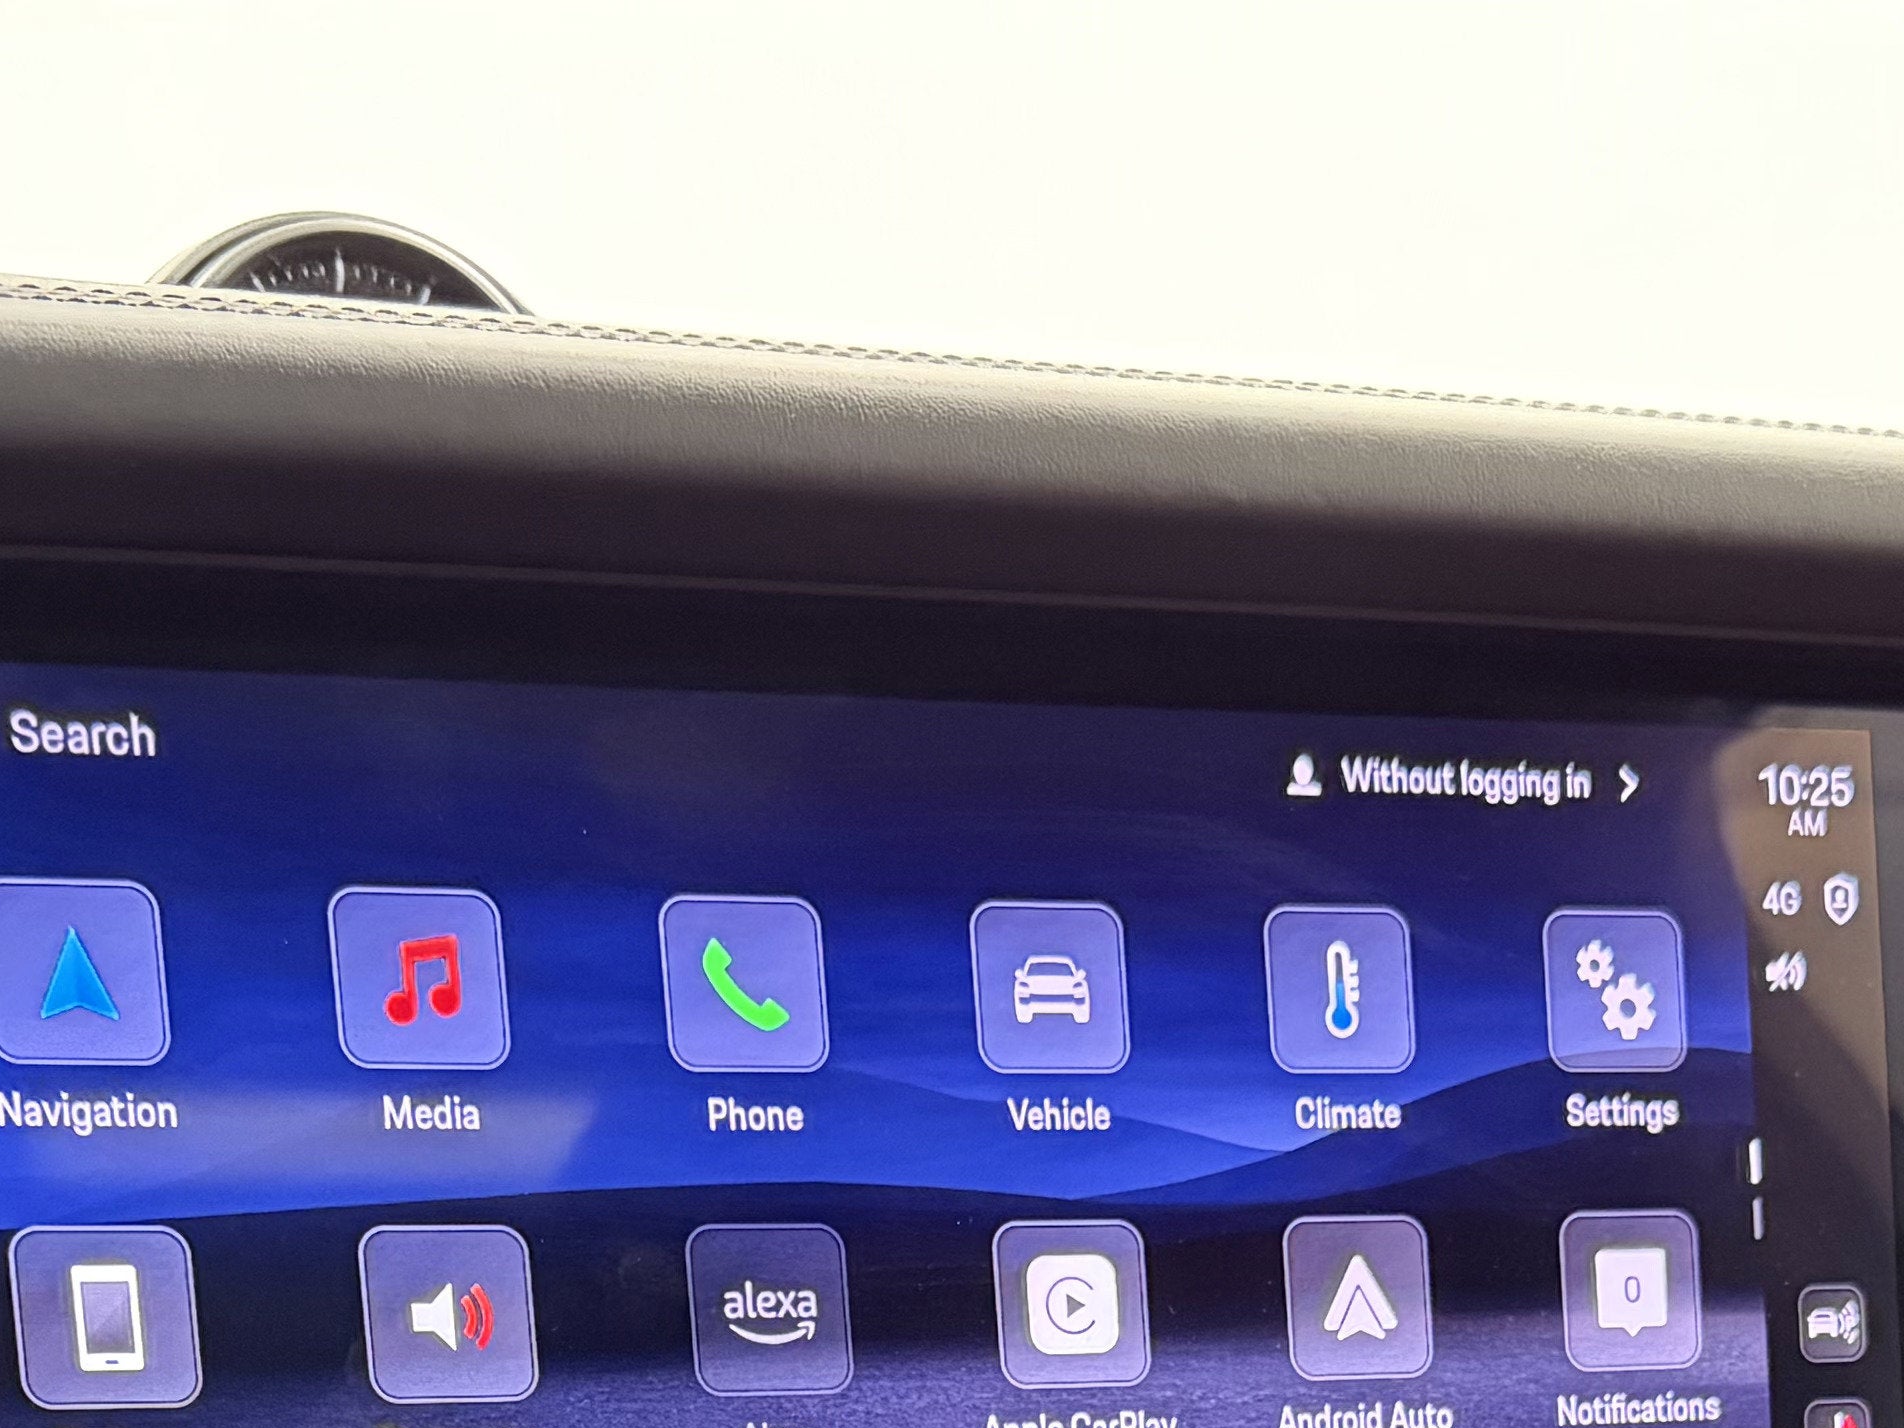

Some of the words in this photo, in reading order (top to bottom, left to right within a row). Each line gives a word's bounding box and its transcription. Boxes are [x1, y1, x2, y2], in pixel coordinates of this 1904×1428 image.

[9, 711, 156, 756] Search
[1340, 756, 1456, 796] Without
[1460, 759, 1558, 804] logging
[1565, 762, 1592, 800] in
[1758, 763, 1855, 807] 10:25
[1787, 808, 1827, 837] AM
[1762, 881, 1802, 916] 4G
[383, 1095, 481, 1130] Media
[708, 1097, 804, 1132] Phone
[1007, 1097, 1111, 1131] Vehicle
[1296, 1097, 1402, 1131] Climate
[1567, 1093, 1680, 1133] Settings
[724, 1281, 818, 1319] alexa
[1624, 1275, 1642, 1304] 0
[1557, 1391, 1722, 1427] Notifications
